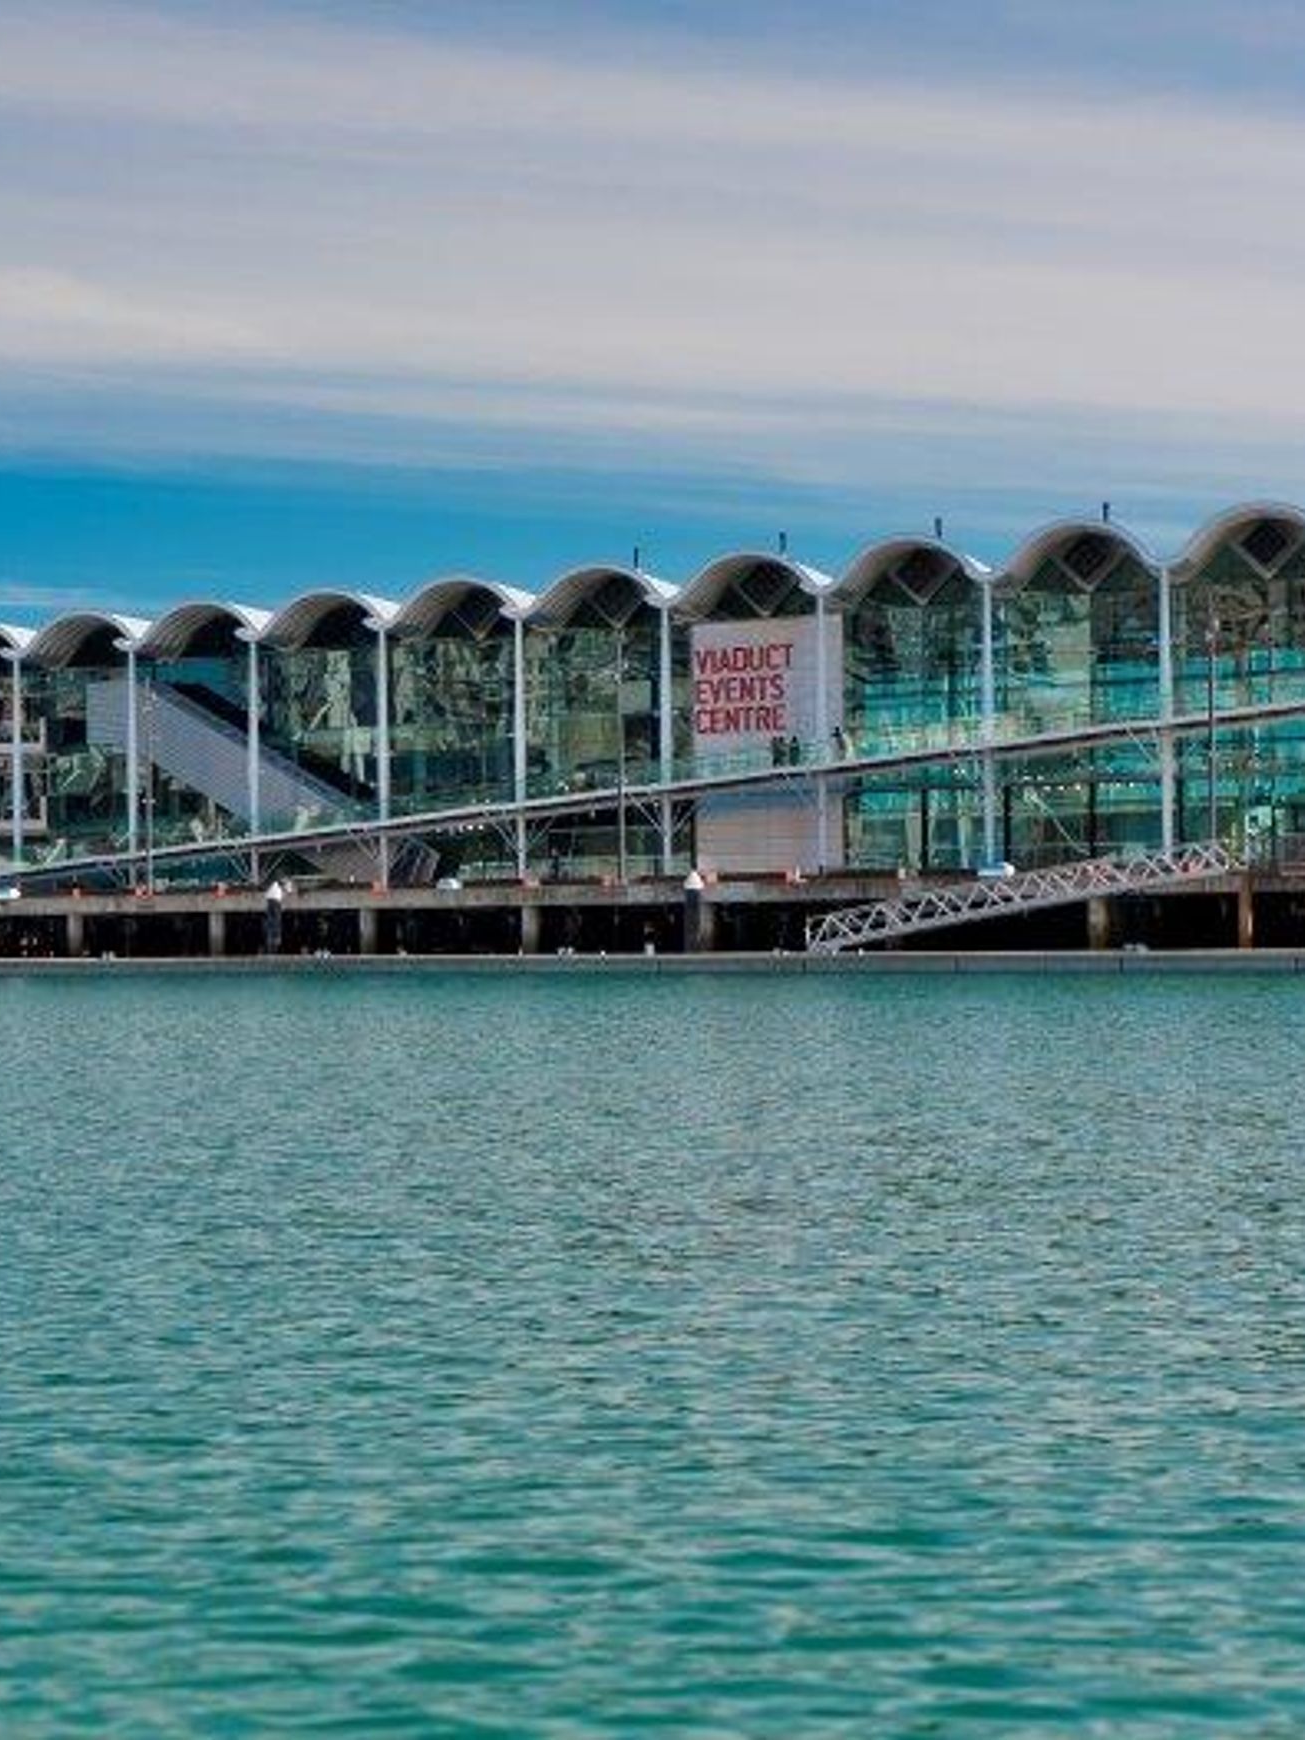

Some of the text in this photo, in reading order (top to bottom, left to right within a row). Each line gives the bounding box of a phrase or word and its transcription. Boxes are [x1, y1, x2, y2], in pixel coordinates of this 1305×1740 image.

[696, 643, 794, 674] VIADUCT
[696, 674, 785, 704] EVENTS
[696, 704, 786, 734] CENTRE
